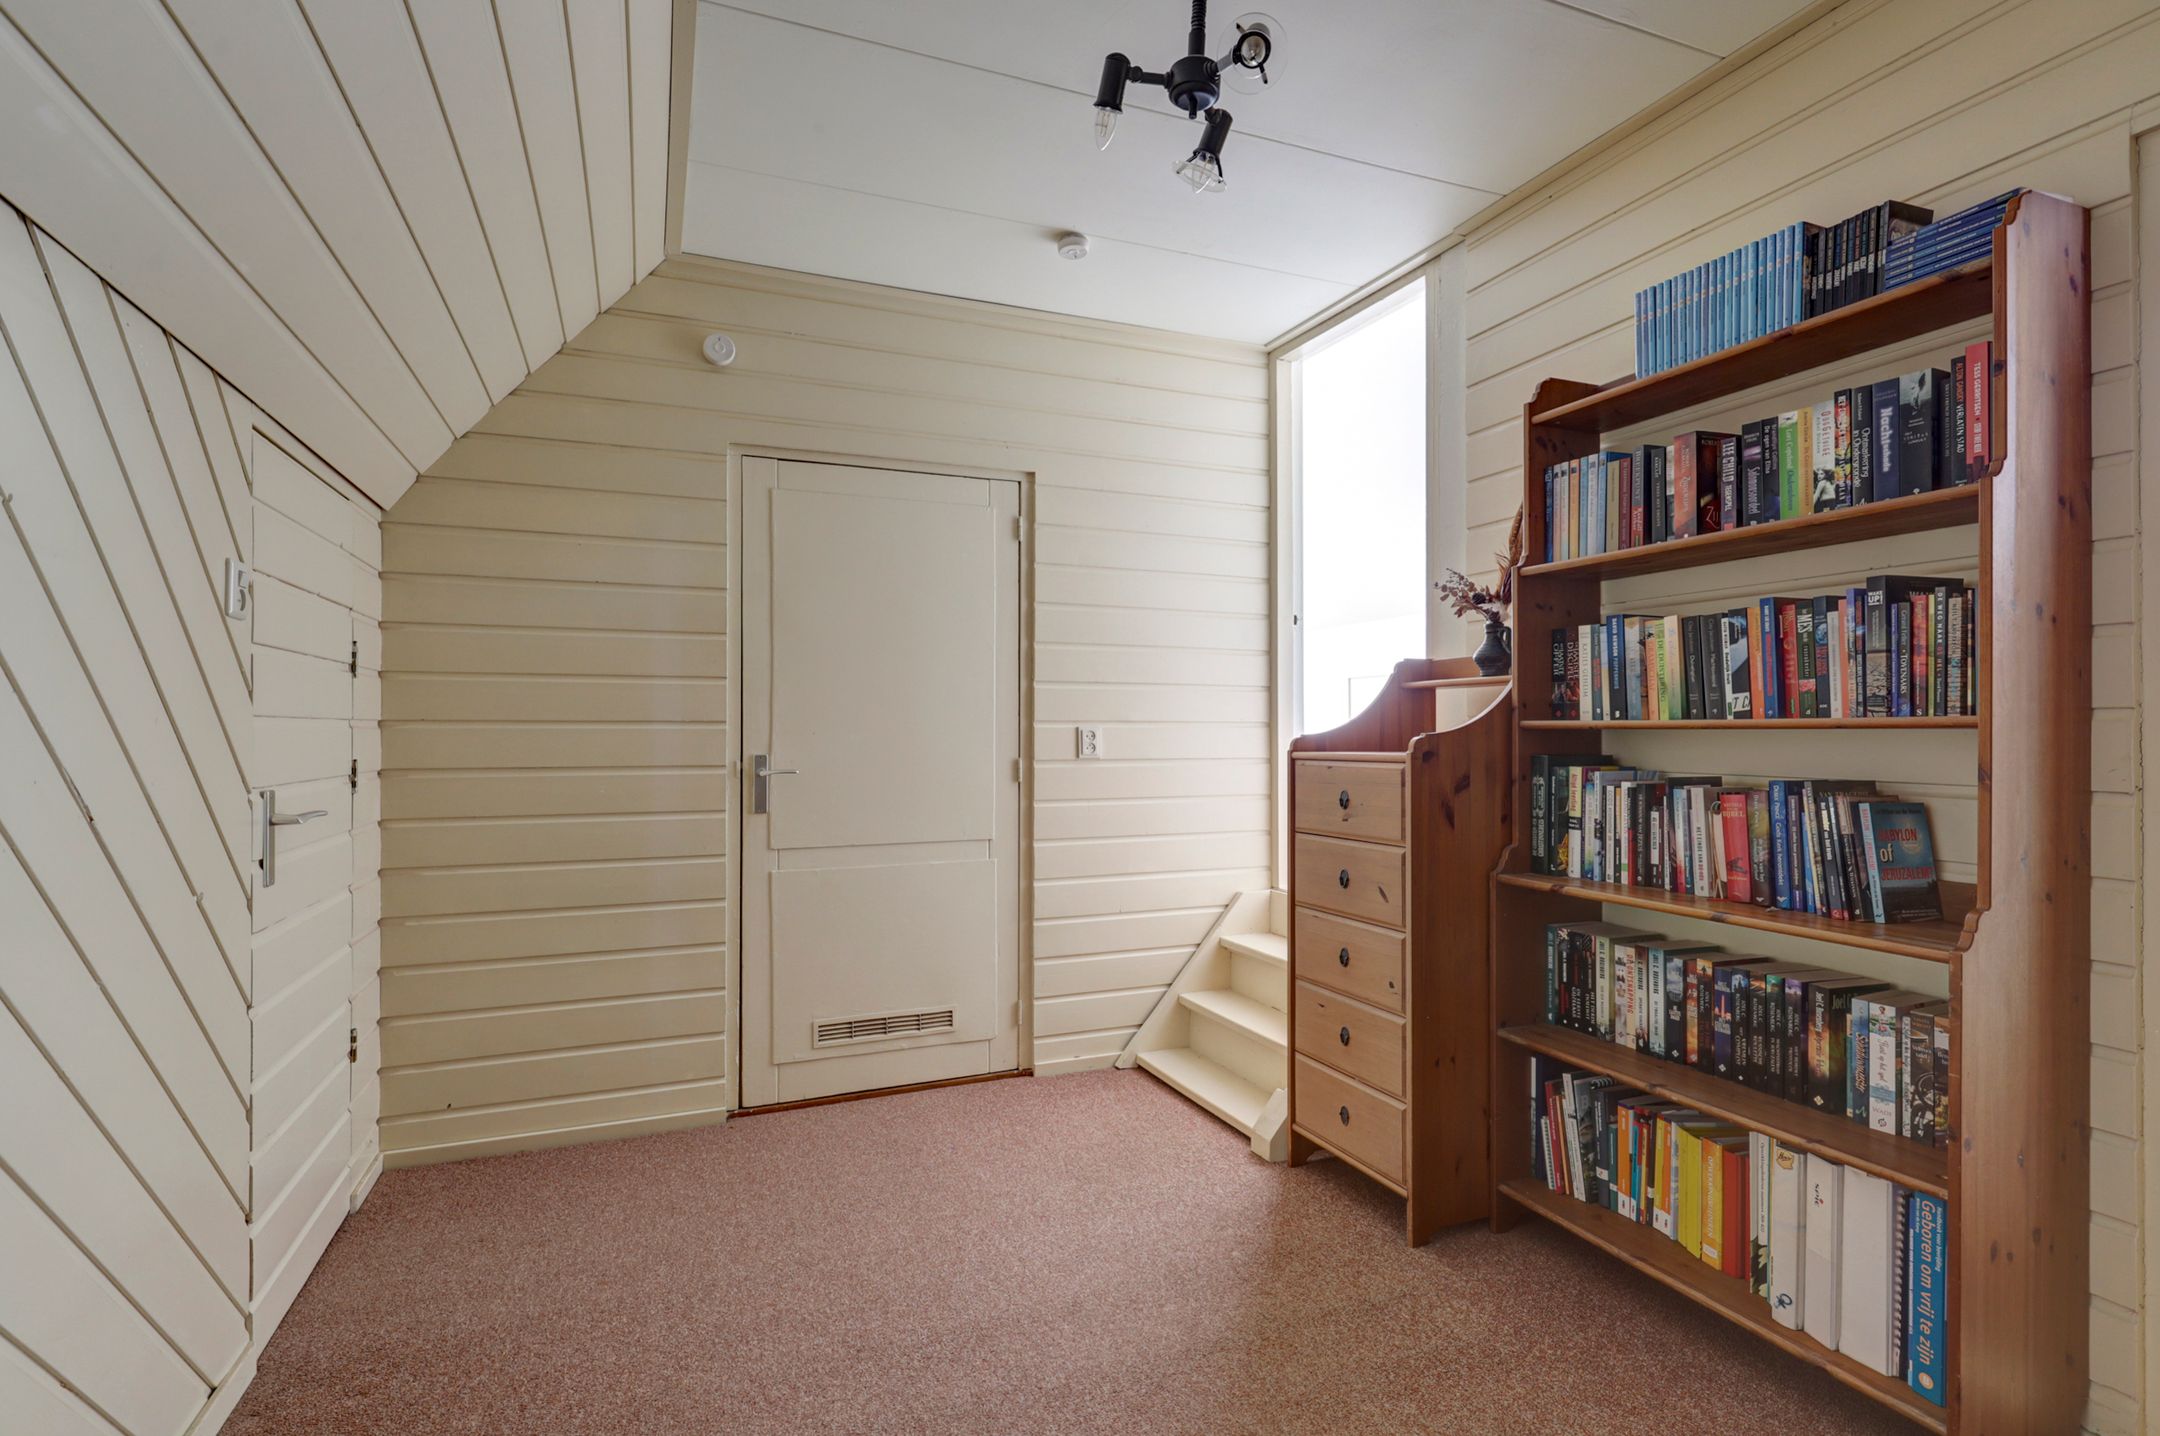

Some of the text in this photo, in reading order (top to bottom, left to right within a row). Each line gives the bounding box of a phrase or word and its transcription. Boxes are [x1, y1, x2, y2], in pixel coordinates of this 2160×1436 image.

[1974, 362, 1982, 416] TESS GERRITSEN
[1764, 425, 1770, 433] De
[1723, 442, 1734, 456] LEE
[1861, 427, 1871, 477] Ontmaskering
[1722, 457, 1734, 482] CHILD
[1937, 592, 1943, 601] DE
[1798, 614, 1812, 633] MES
[1900, 654, 1908, 694] TOVENAARS
[1877, 828, 1917, 841] BABYLON
[1880, 843, 1894, 863] of
[1815, 992, 1824, 1002] Joel
[1815, 1007, 1824, 1033] Rosenberg
[1917, 1200, 1936, 1366] Geboren om vrij te zijn
